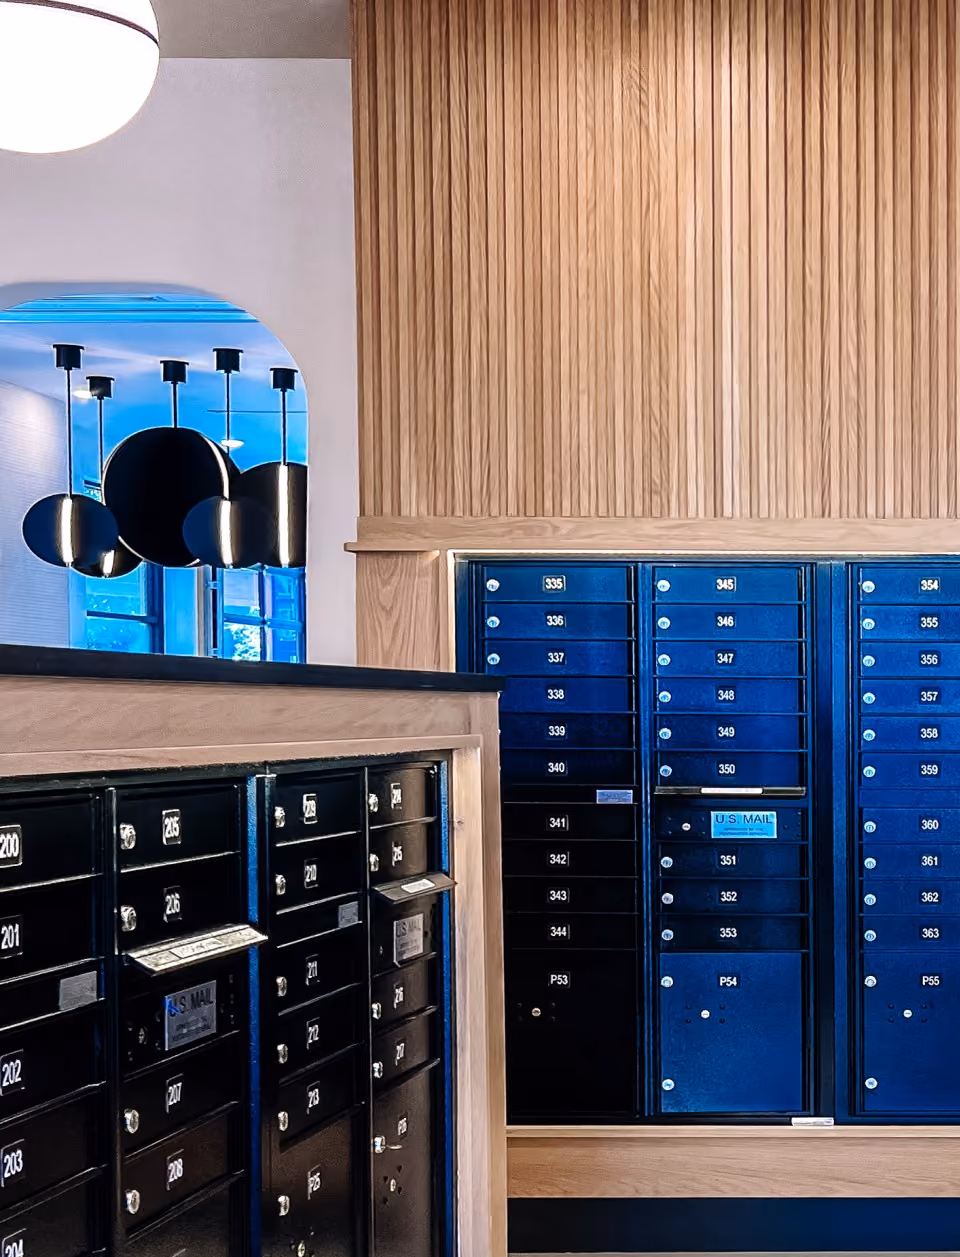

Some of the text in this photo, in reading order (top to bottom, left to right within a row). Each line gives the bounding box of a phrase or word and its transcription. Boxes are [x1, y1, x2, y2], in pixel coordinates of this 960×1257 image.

[545, 576, 563, 590] 335
[717, 577, 734, 591] 345
[920, 579, 938, 591] 354
[546, 614, 564, 626] 336
[717, 615, 734, 627] 346
[920, 616, 938, 628] 355
[547, 652, 565, 663] 337
[717, 652, 734, 664] 347
[920, 654, 938, 665] 356
[547, 688, 565, 700] 338
[718, 689, 735, 701] 348
[920, 691, 938, 702] 357
[548, 725, 566, 737] 339
[718, 726, 735, 737] 349
[920, 727, 938, 739] 358
[547, 762, 565, 773] 340
[718, 763, 736, 775] 350
[920, 764, 938, 775] 359
[549, 817, 566, 828] 341
[715, 814, 773, 825] U.S. MAIL
[921, 819, 939, 830] 360
[165, 816, 180, 838] 205
[0, 832, 19, 858] 200
[549, 853, 567, 865] 342
[720, 854, 736, 866] 351
[921, 855, 938, 867] 361
[549, 890, 567, 901] 343
[720, 891, 738, 902] 352
[921, 891, 939, 903] 362
[165, 893, 180, 915] 206
[1, 923, 20, 949] 201
[550, 926, 567, 937] 344
[719, 927, 737, 938] 353
[921, 927, 939, 939] 363
[550, 974, 568, 985] P53
[719, 976, 737, 987] P54
[922, 975, 940, 986] P55
[2, 1059, 22, 1086] 202
[168, 1082, 182, 1106] 207
[4, 1149, 23, 1178] 203
[168, 1158, 183, 1183] 208
